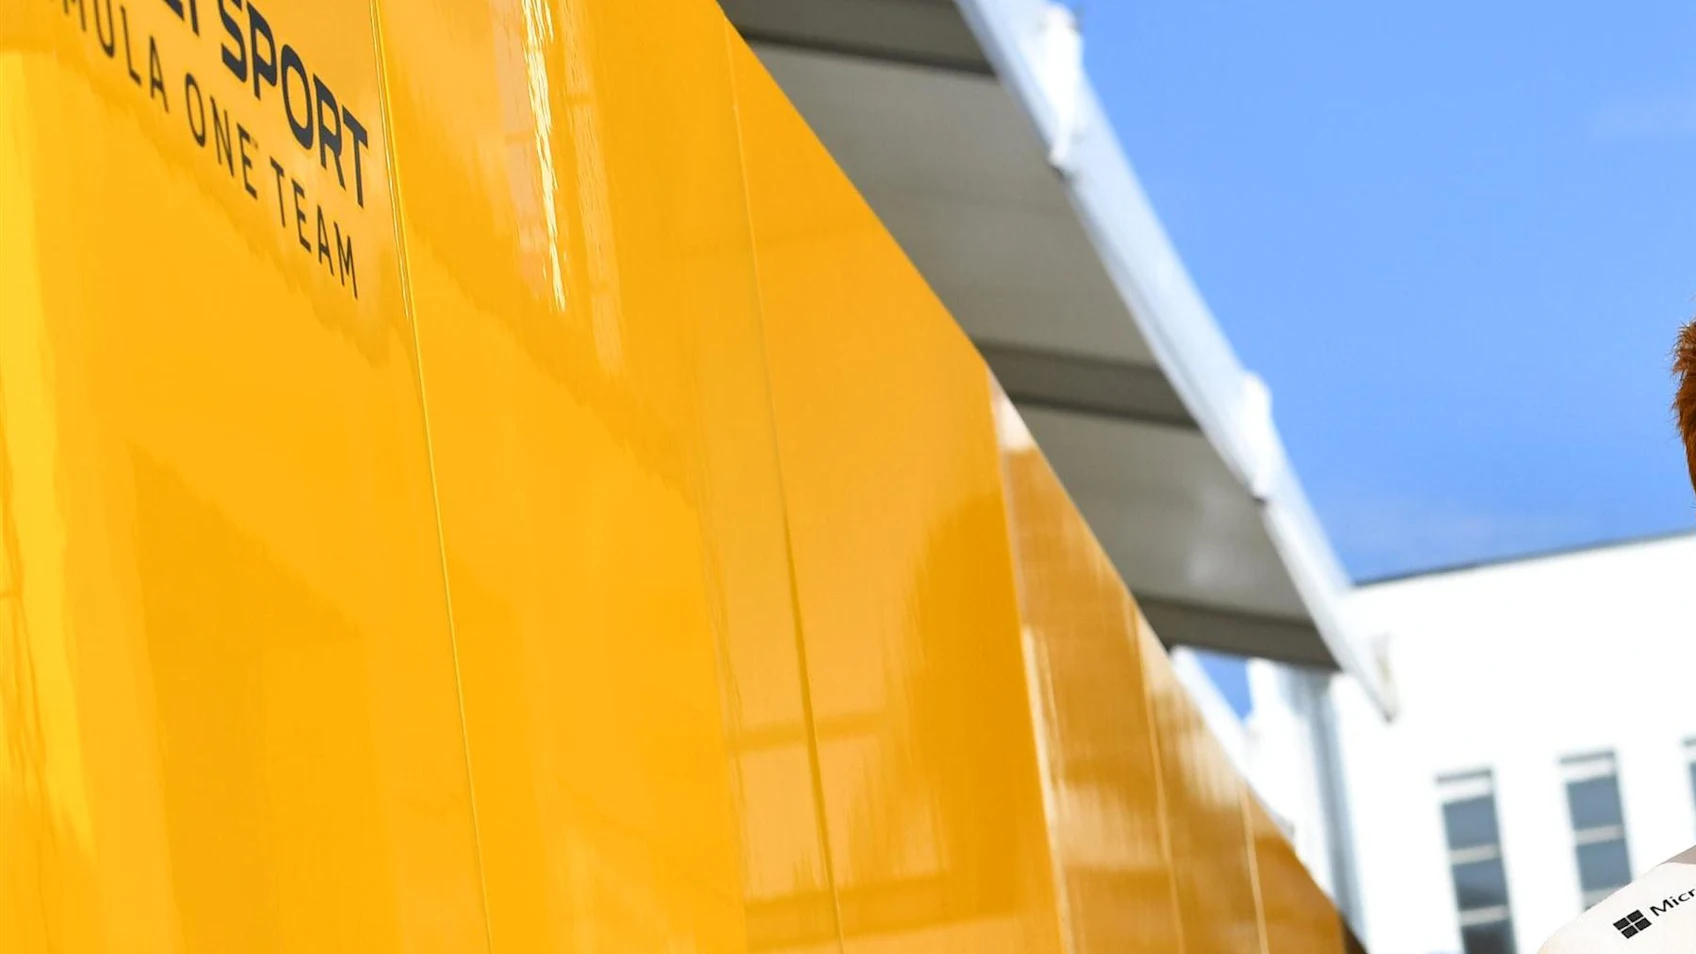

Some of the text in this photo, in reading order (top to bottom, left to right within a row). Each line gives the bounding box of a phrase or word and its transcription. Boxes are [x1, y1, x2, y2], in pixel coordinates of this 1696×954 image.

[185, 72, 258, 201] ONE
[269, 156, 359, 300] TEAM
[218, 0, 368, 209] SPORT
